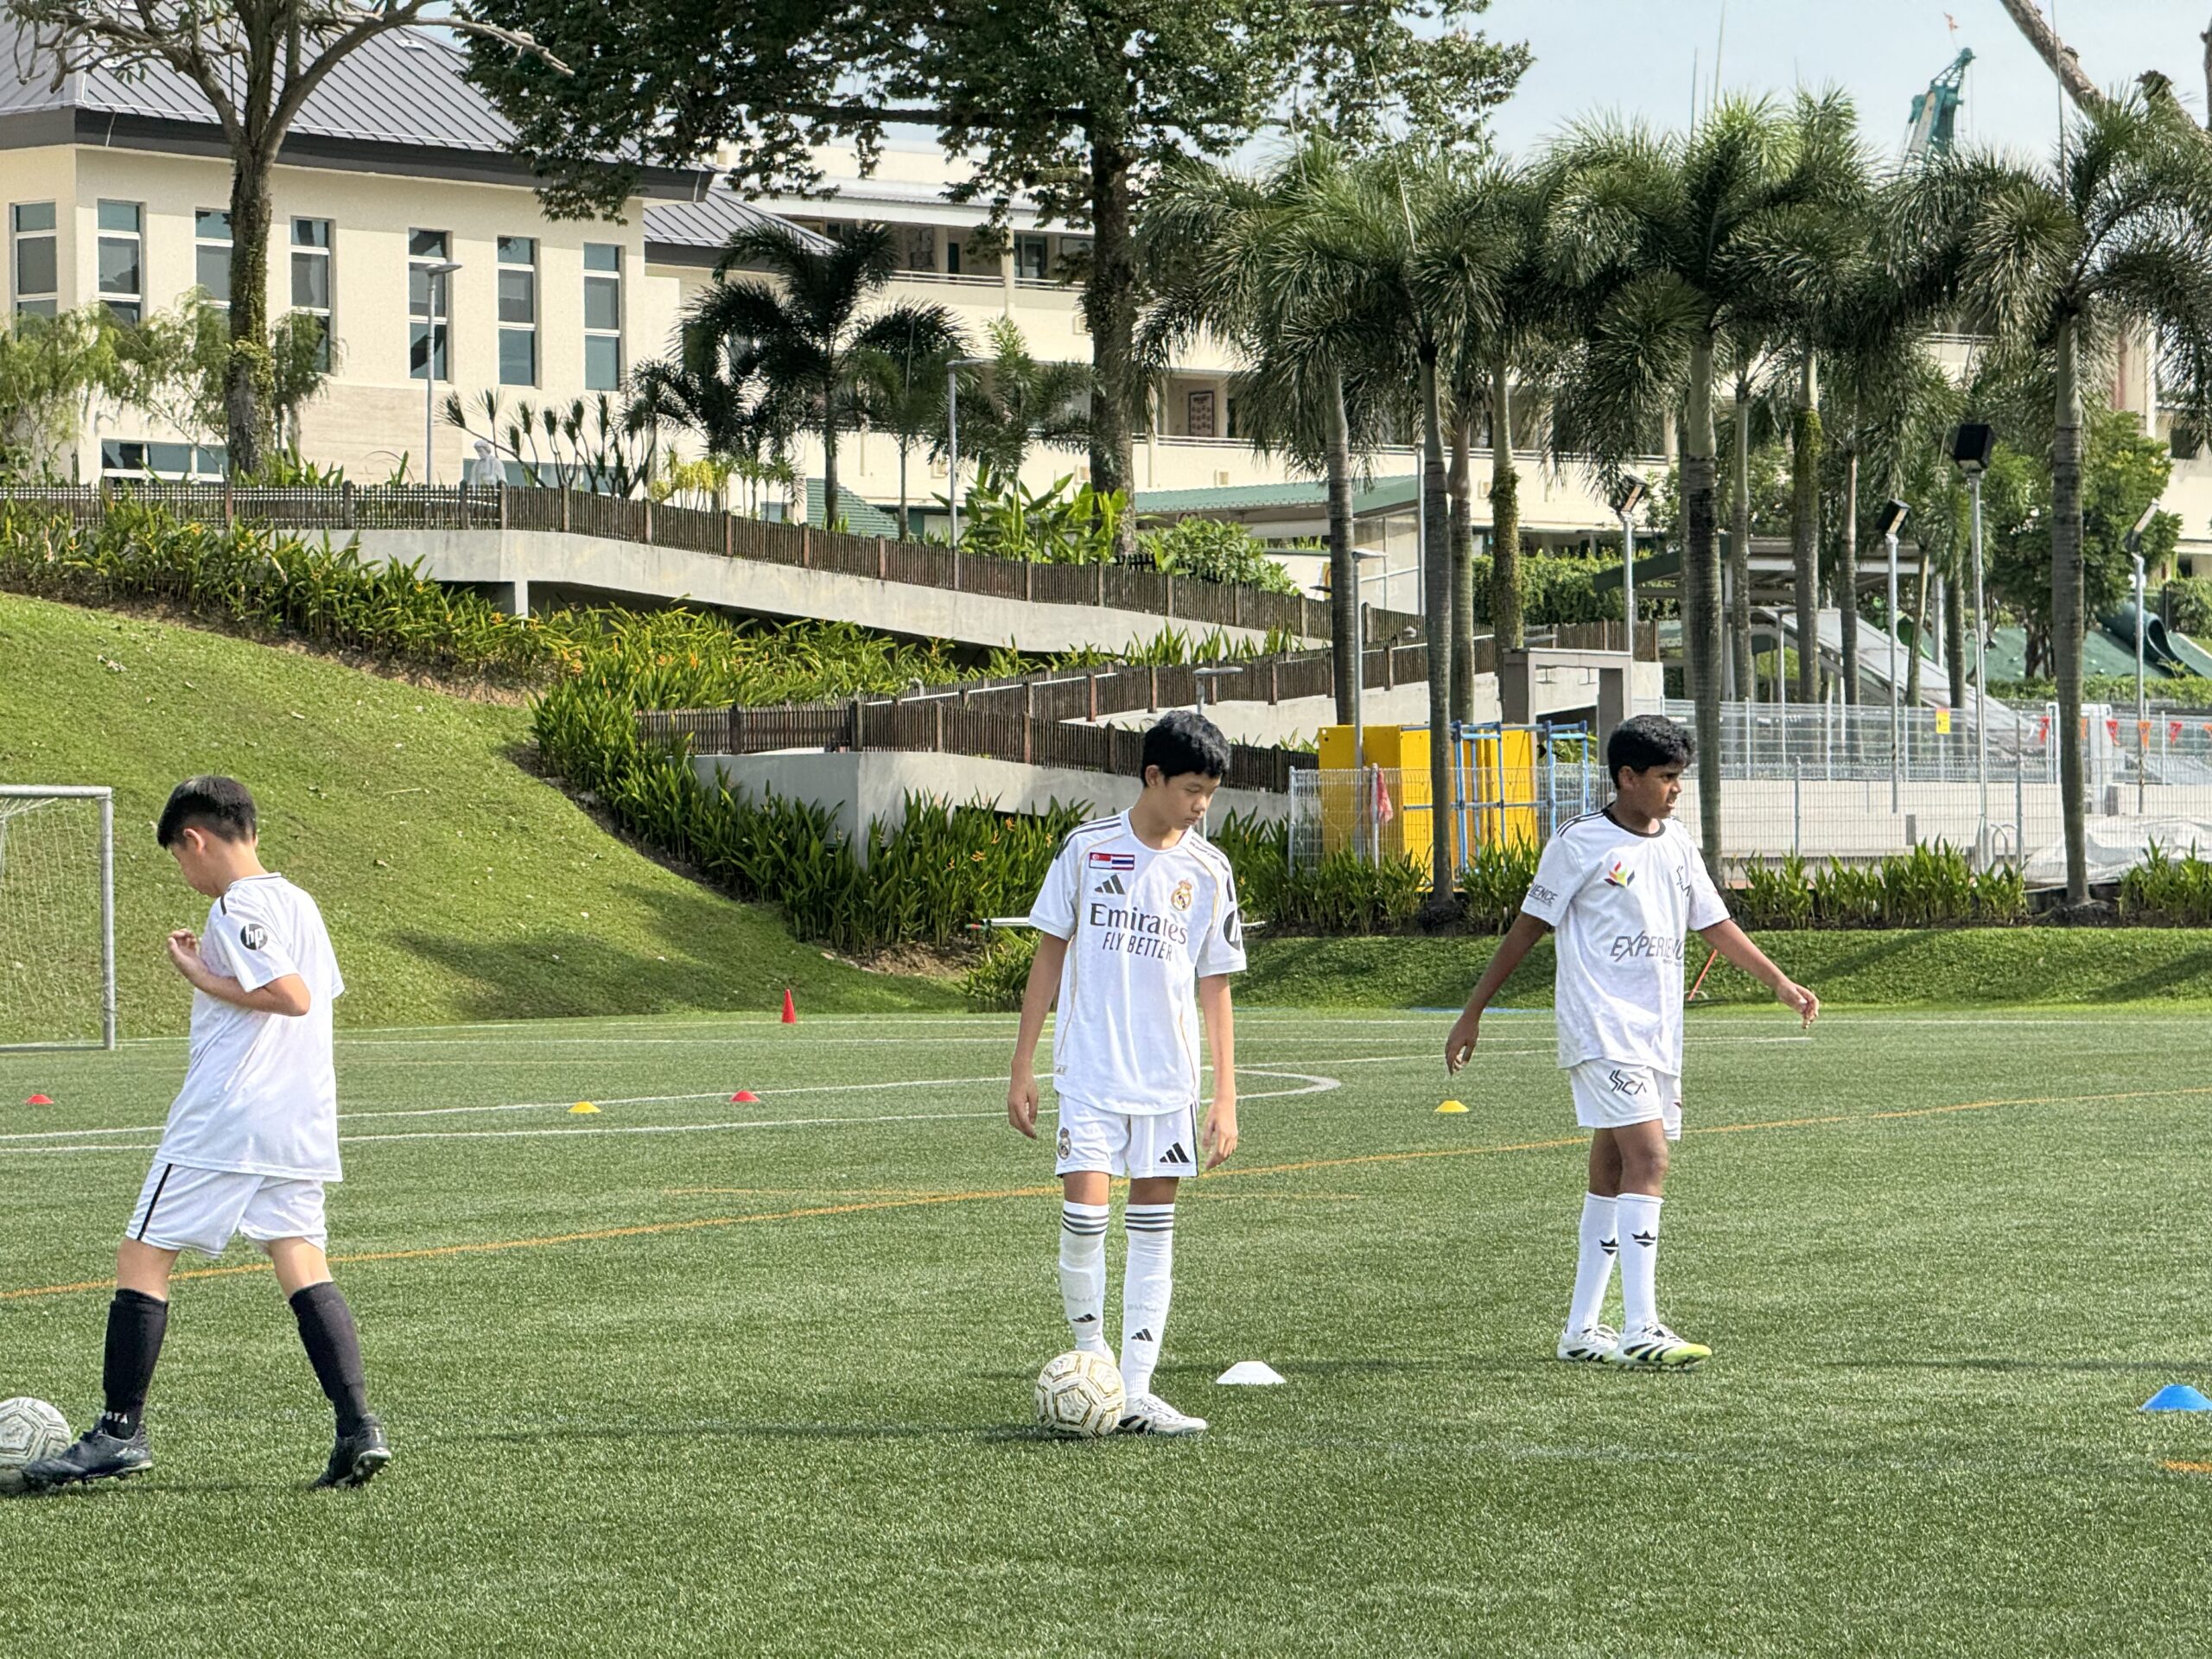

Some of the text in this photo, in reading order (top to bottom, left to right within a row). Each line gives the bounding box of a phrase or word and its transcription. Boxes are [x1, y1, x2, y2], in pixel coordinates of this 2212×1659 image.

[245, 924, 264, 950] hp
[1090, 902, 1188, 944] Emirates
[1102, 931, 1173, 961] FLY BETTER
